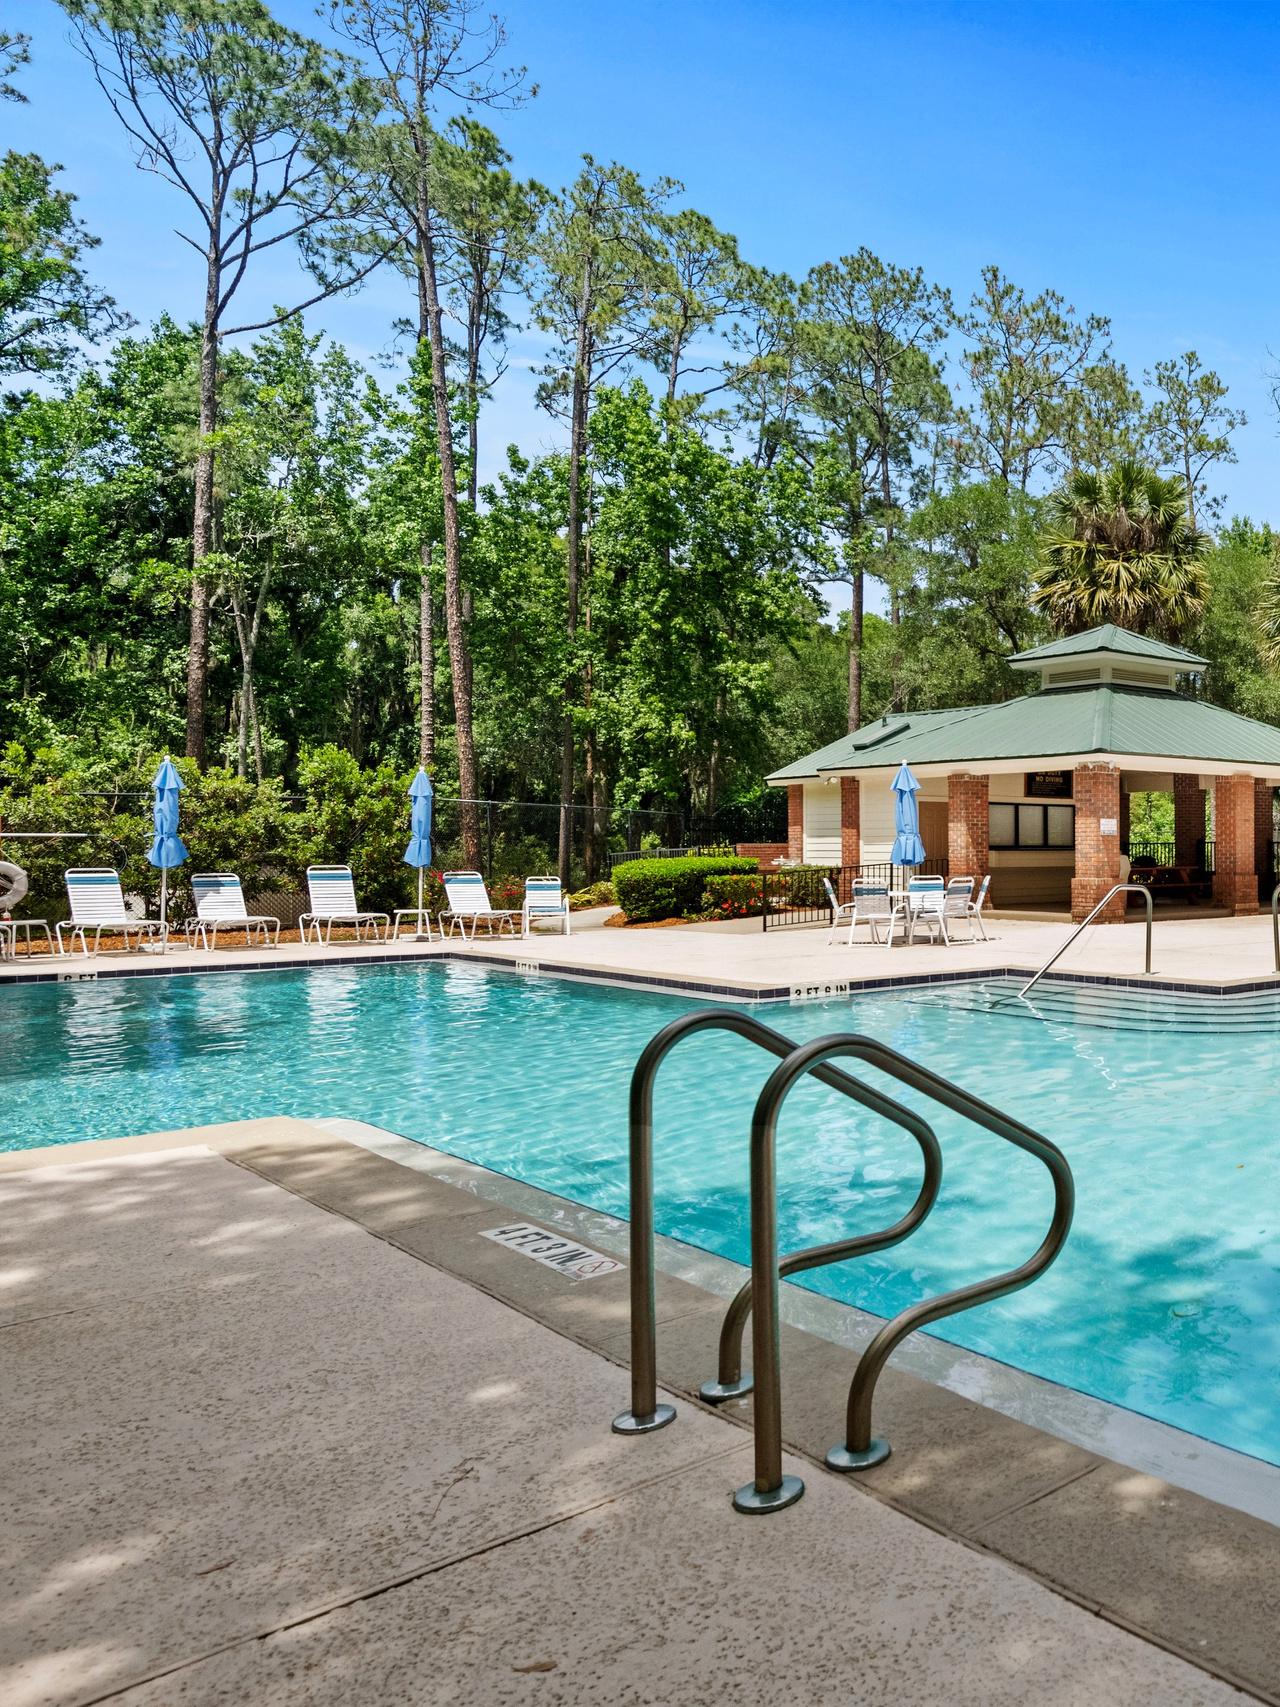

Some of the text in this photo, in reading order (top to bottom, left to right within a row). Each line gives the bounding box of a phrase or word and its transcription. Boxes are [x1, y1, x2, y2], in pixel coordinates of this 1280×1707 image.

[807, 986, 820, 995] FT
[836, 984, 847, 992] IN
[493, 1226, 529, 1237] 4
[530, 1242, 568, 1254] 3
